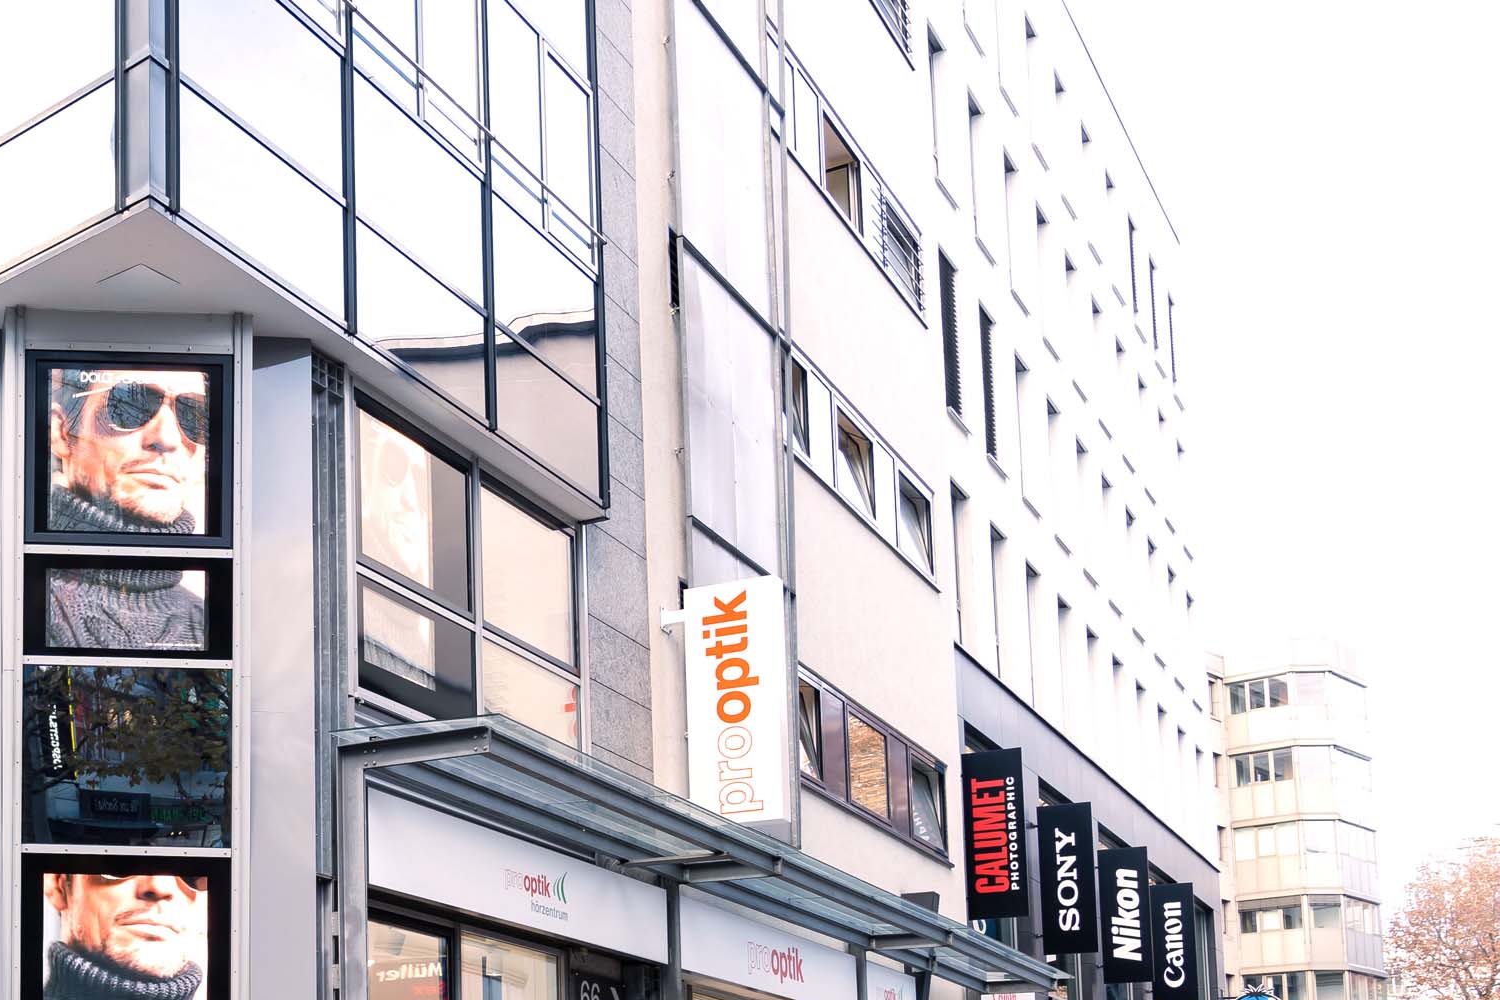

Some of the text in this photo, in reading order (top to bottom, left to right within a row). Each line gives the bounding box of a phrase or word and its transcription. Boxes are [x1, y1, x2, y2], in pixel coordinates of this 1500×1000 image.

[702, 590, 764, 814] prooptik
[971, 778, 1010, 894] CALUMET
[1006, 776, 1020, 891] PHOTOGRAPHIC
[1055, 828, 1080, 931] SONY
[747, 942, 804, 984] prooptik
[1111, 868, 1142, 961] Nikon
[1163, 901, 1185, 988] Canon
